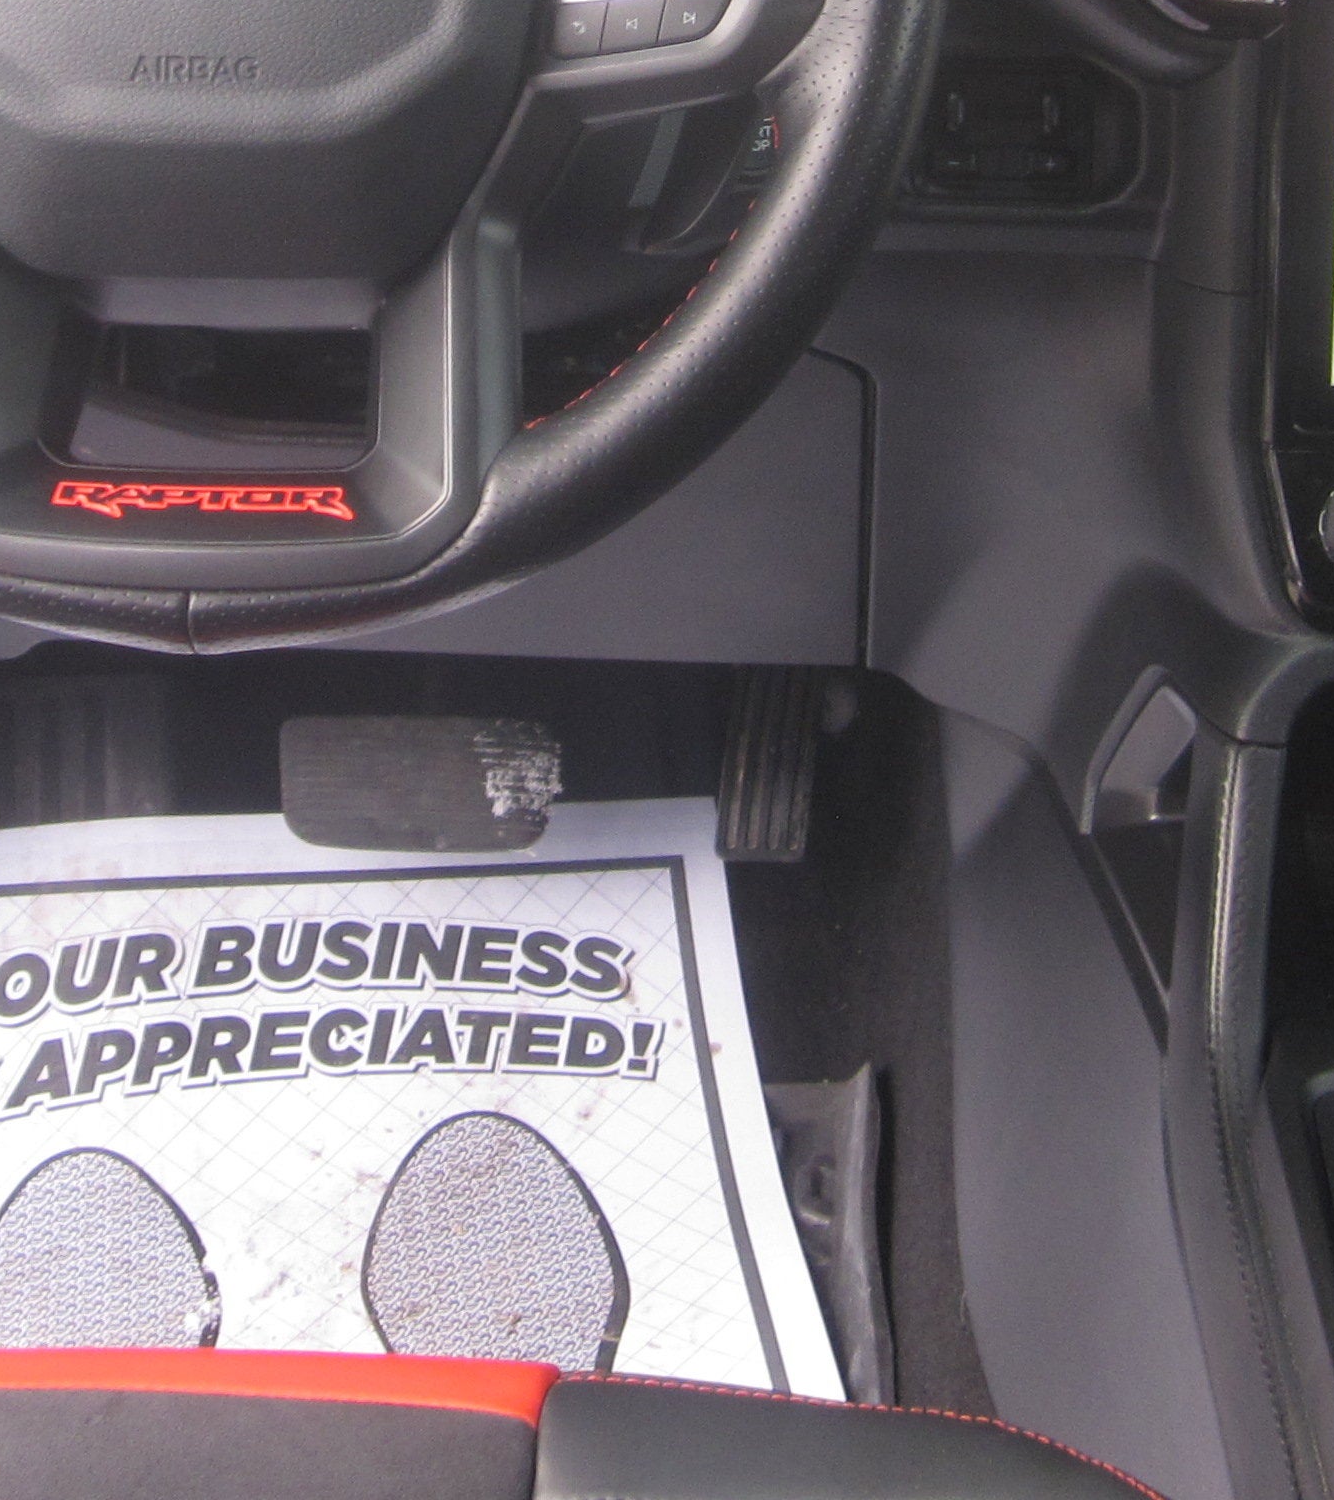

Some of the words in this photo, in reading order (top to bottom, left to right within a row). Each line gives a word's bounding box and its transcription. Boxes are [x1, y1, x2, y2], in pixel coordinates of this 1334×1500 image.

[129, 54, 263, 84] AIRBAG
[50, 480, 356, 522] RAPTOR
[193, 922, 631, 998] BUSINESS
[5, 1008, 659, 1110] APPRECIATED!
